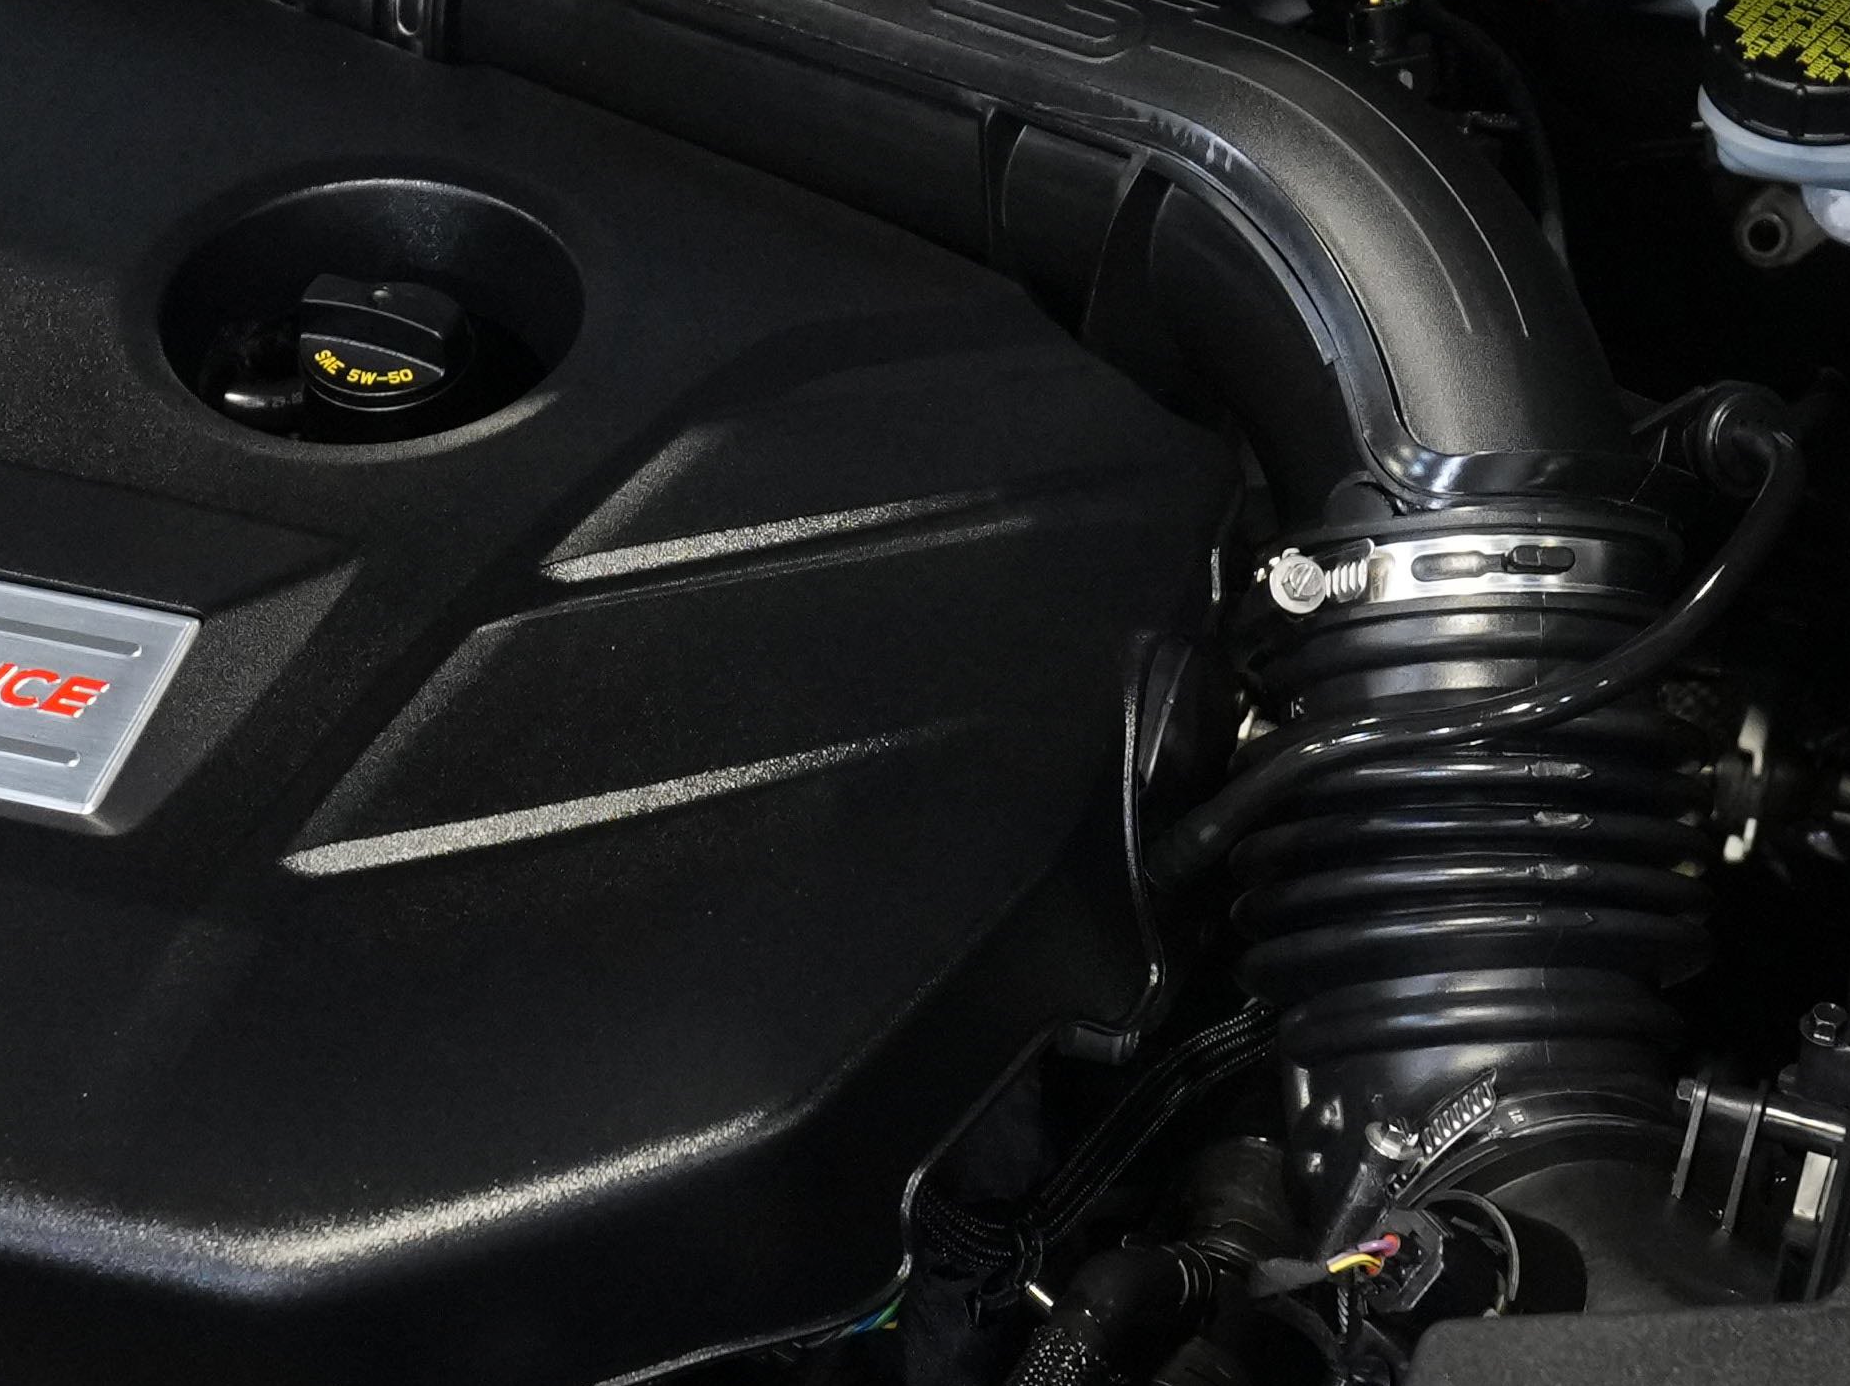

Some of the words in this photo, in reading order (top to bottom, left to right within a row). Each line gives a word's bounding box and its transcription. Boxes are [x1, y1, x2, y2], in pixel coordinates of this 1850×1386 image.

[1801, 9, 1819, 22] LE
[1802, 54, 1834, 78] FROM
[1818, 63, 1844, 82] USE
[314, 348, 346, 375] SAE
[346, 368, 414, 386] 5W-50
